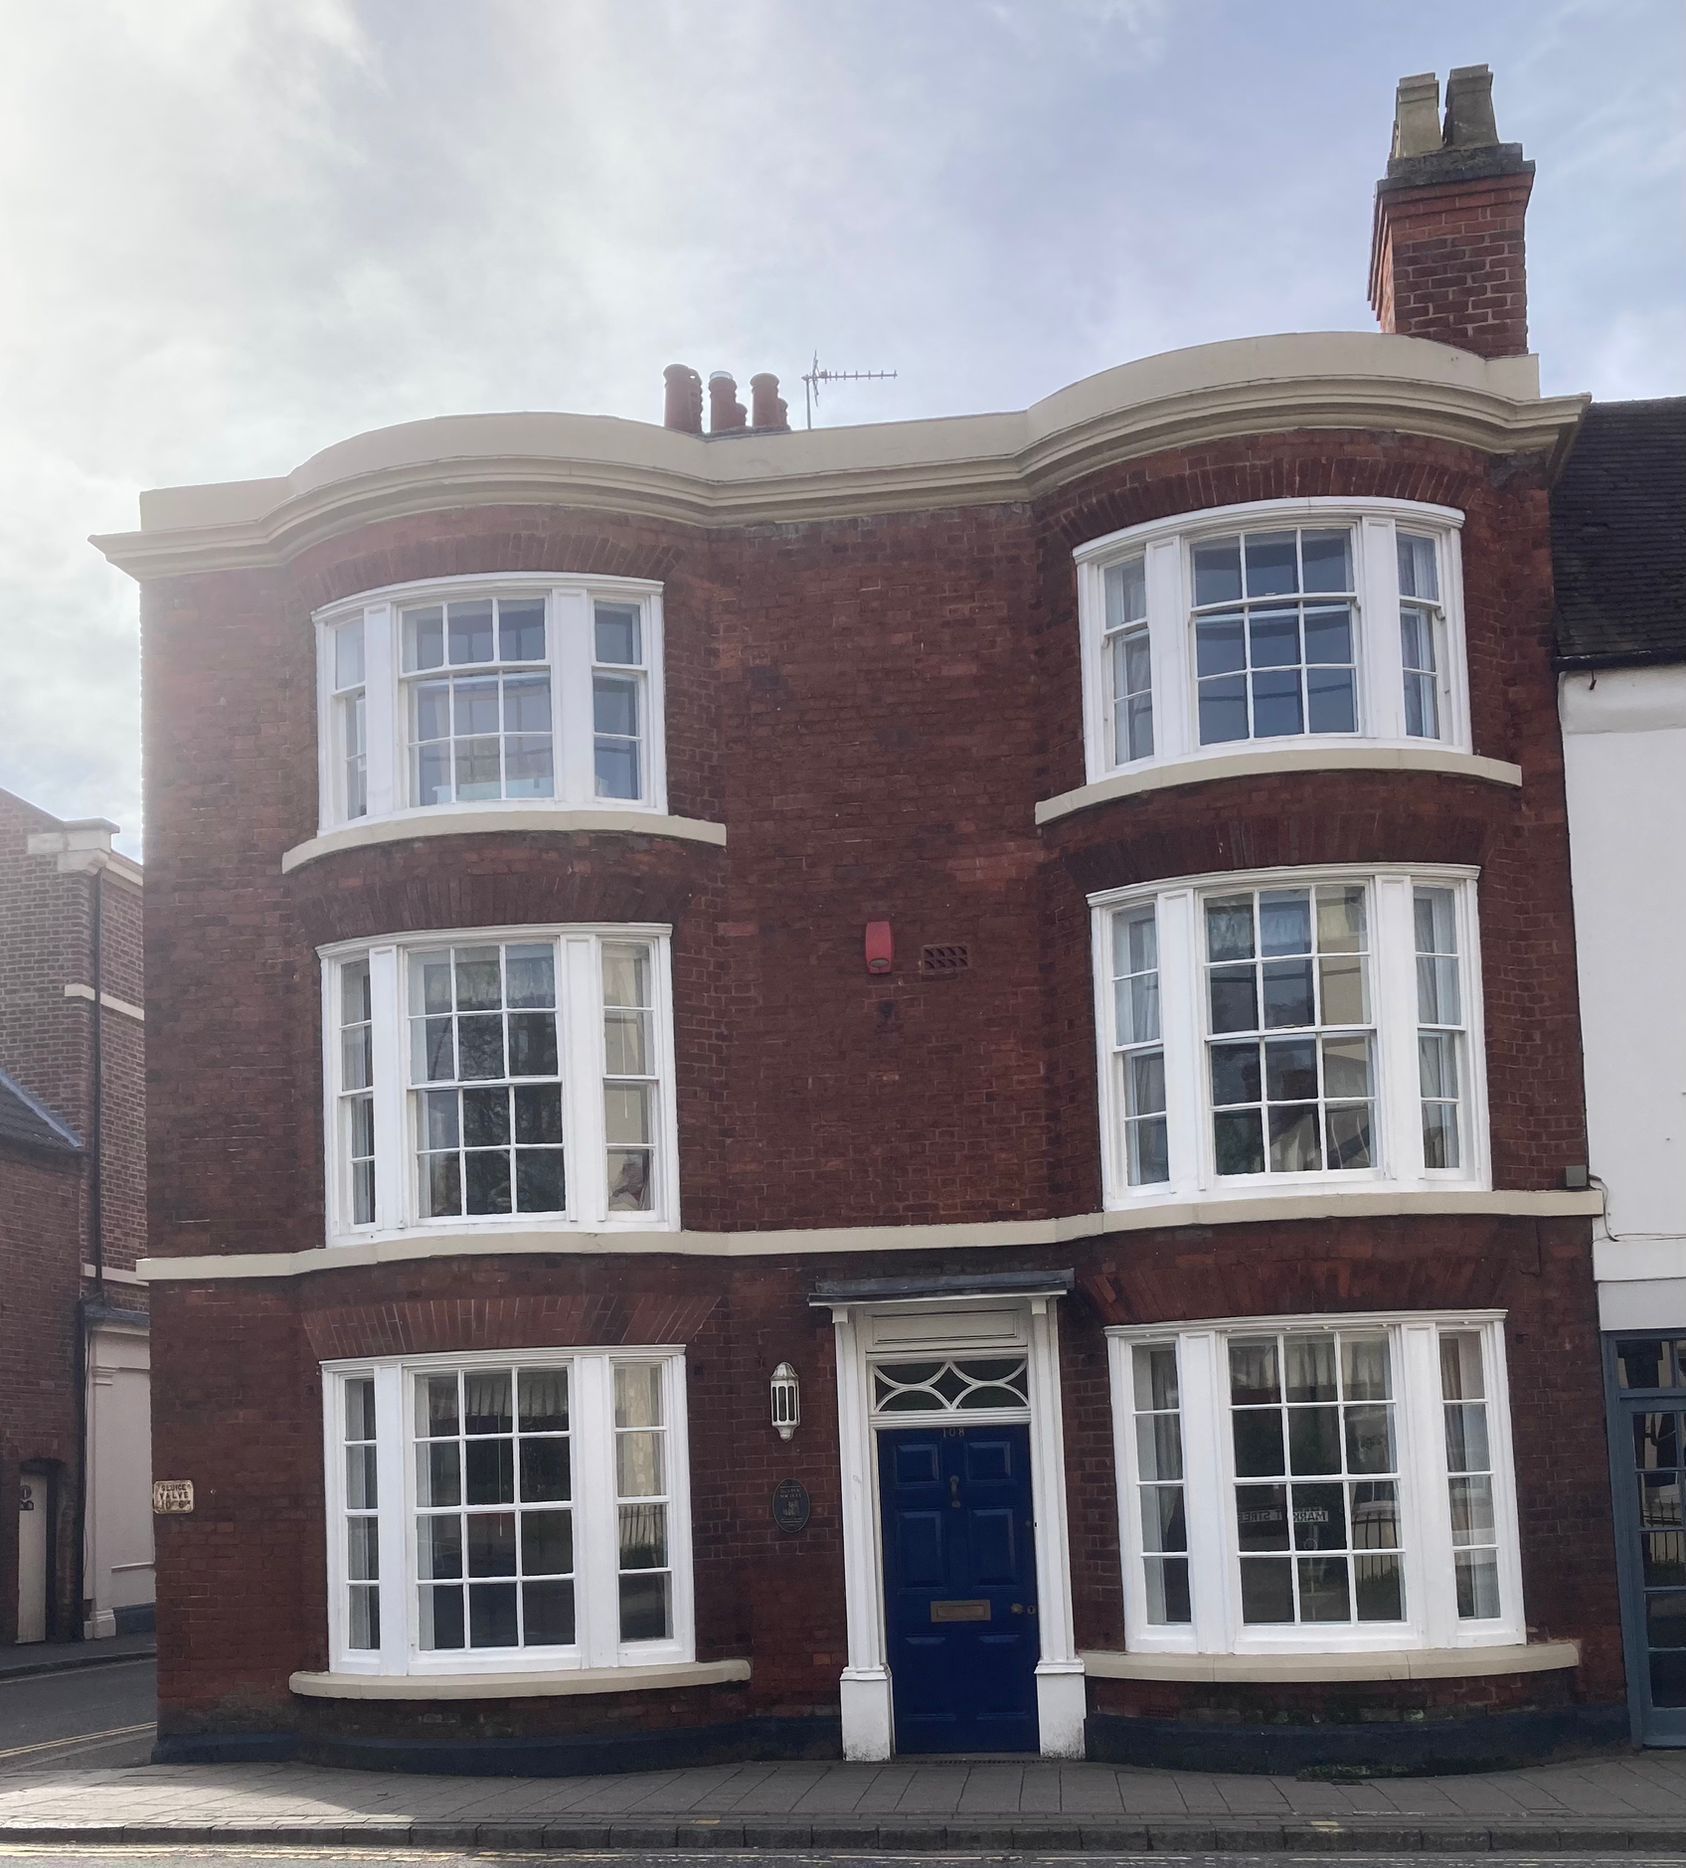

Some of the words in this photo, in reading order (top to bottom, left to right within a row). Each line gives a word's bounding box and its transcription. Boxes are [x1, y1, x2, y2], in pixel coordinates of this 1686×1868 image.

[943, 1427, 965, 1438] 108
[161, 1483, 187, 1491] SLUICE
[159, 1491, 189, 1499] VALVE
